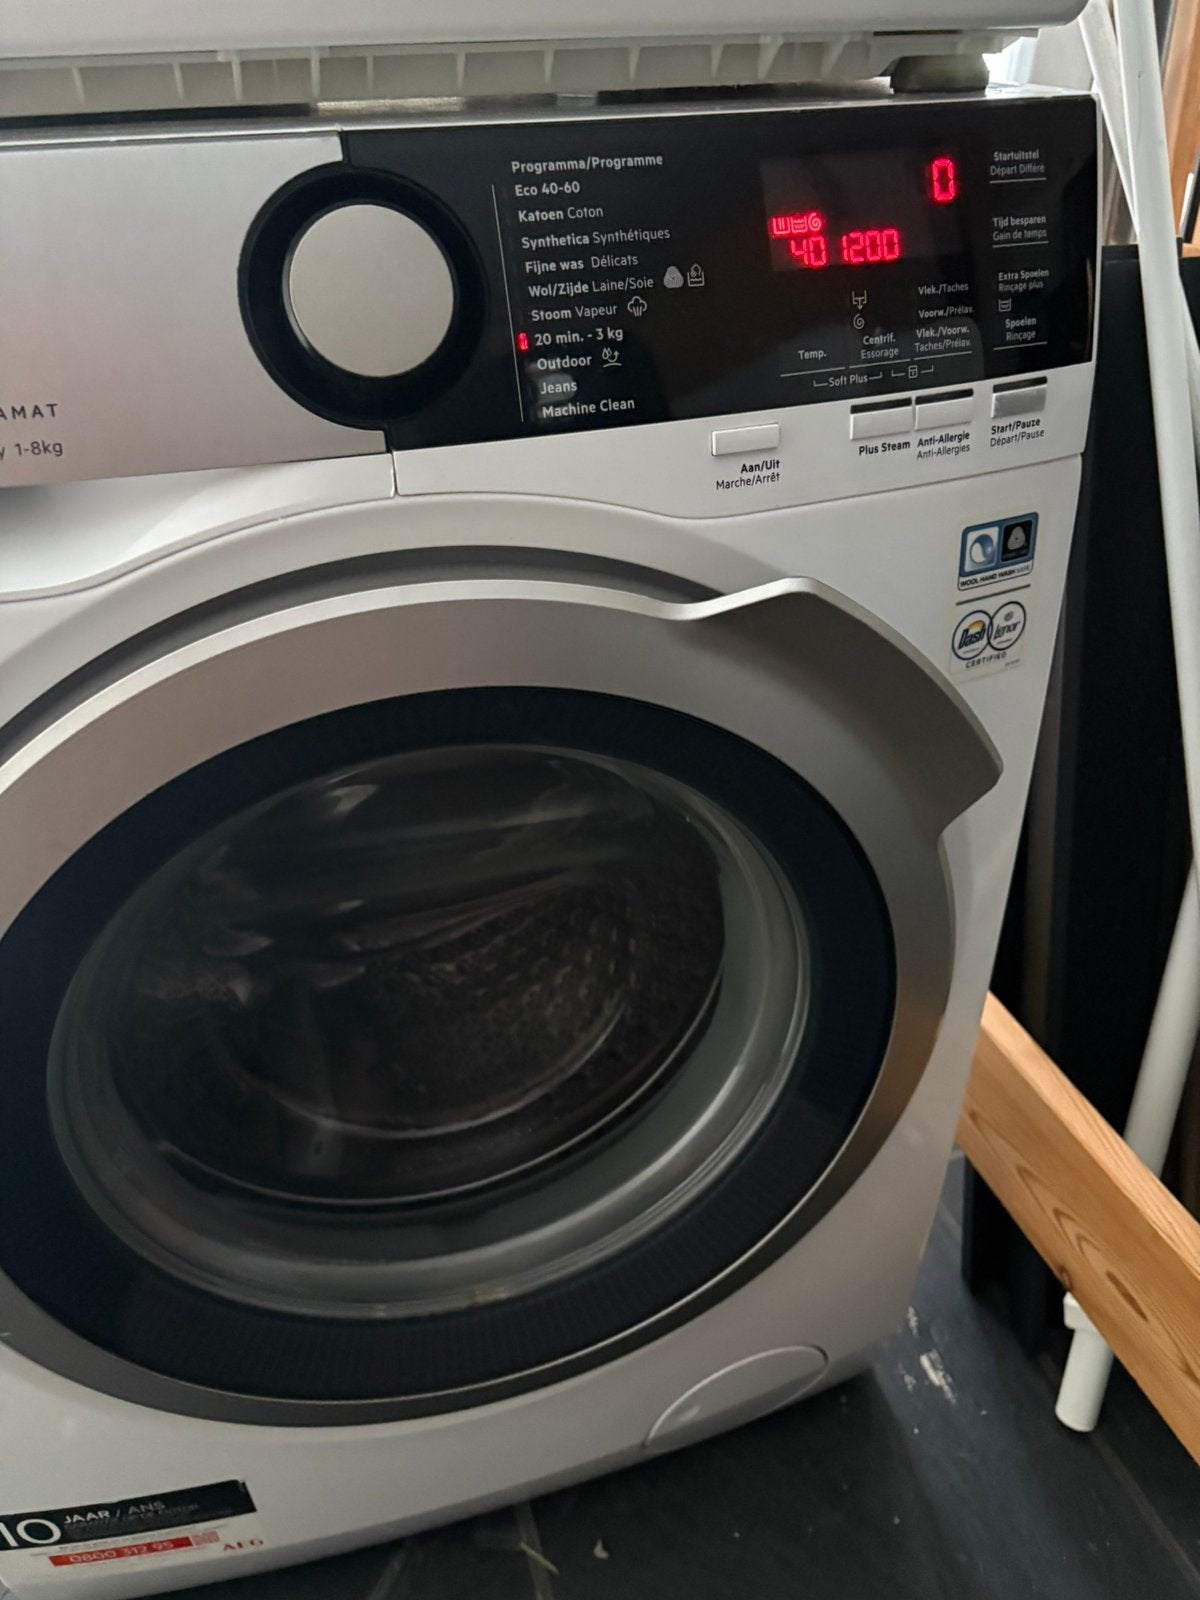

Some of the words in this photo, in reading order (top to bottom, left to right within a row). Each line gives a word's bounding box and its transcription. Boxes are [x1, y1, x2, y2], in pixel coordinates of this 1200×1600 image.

[993, 149, 1040, 162] Startuitstel
[511, 154, 663, 175] Programma/Programme
[932, 158, 955, 201] 0
[514, 184, 538, 197] Eco
[541, 181, 581, 196] 40-60
[518, 209, 564, 223] Katoen
[567, 207, 604, 220] Coton
[992, 217, 1009, 229] Tijd
[1010, 215, 1047, 227] besparen
[521, 232, 590, 251] Synthetica
[592, 228, 671, 246] Synthétiques
[992, 230, 1011, 241] Gain
[1012, 229, 1022, 239] de
[1024, 229, 1047, 240] temps
[790, 235, 827, 267] 40
[841, 228, 900, 264] 1200
[525, 258, 557, 275] Fijne
[560, 259, 584, 271] was
[591, 254, 639, 269] Délicats
[998, 272, 1019, 282] Extra
[1020, 268, 1050, 280] Spoelen
[528, 282, 590, 299] Wol/Zijde
[592, 276, 654, 293] Laine/Soie
[918, 282, 969, 296] Vlek./Taches
[531, 308, 572, 322] Stoom
[575, 304, 618, 320] Vapeur
[1005, 316, 1037, 329] Spoelen
[534, 334, 552, 347] 20
[556, 330, 584, 345] min.
[596, 328, 605, 341] 3
[607, 326, 624, 342] kg
[862, 333, 896, 346] Centrif.
[916, 326, 970, 340] Vlek./Voorw.
[1006, 330, 1036, 342] Rinçage
[798, 349, 827, 362] Temp.
[861, 347, 899, 361] Essorage
[537, 355, 592, 370] Outdoor
[540, 379, 578, 395] Jeans
[828, 375, 847, 388] Soft
[850, 373, 868, 385] Plus
[542, 400, 596, 419] Machine
[600, 398, 635, 413] Clean
[991, 417, 1041, 436] Start/Pauze
[917, 431, 970, 448] Anti-Allergie
[990, 428, 1045, 448] Départ/Pause
[15, 440, 63, 457] 1-8kg
[858, 444, 879, 457] Plus
[881, 439, 911, 453] Steam
[916, 443, 970, 460] Anti-Allergies
[741, 459, 780, 474] Aan/Uit
[716, 472, 780, 491] Marche/Arrêt
[960, 578, 979, 588] WOOL
[958, 626, 986, 650] Dash
[993, 621, 1021, 640] Lenor
[965, 651, 1006, 669] CERTIFIED
[64, 1509, 111, 1524] JAAR
[128, 1501, 165, 1515] ANS
[70, 1550, 117, 1563] 0800
